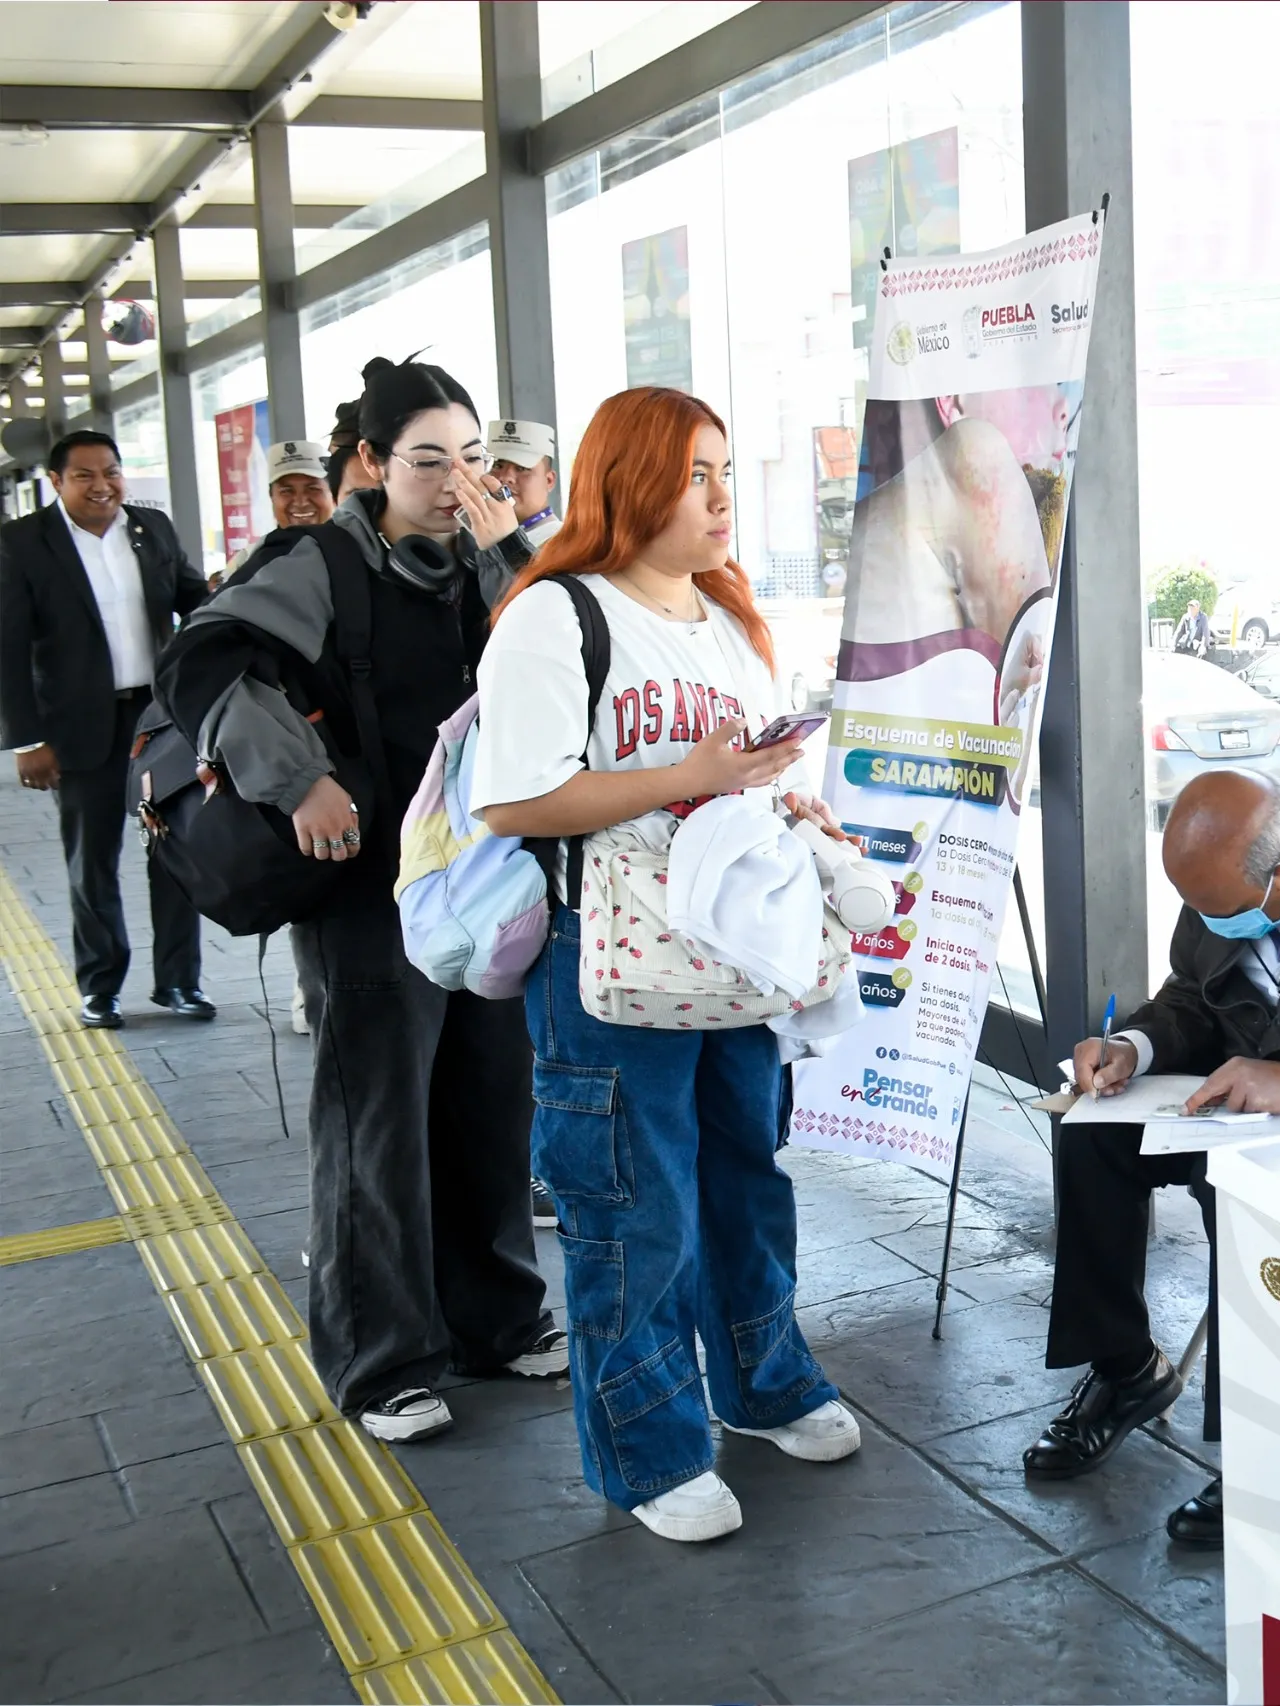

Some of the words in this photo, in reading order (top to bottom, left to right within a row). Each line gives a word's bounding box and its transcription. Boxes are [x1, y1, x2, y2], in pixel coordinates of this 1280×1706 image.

[981, 303, 1035, 327] PUEBLA
[1051, 299, 1089, 324] Salud
[916, 324, 939, 335] Gobierno
[940, 321, 947, 330] de
[982, 328, 1005, 337] Gobierno
[1006, 325, 1014, 334] del
[1015, 324, 1037, 332] Estado
[917, 333, 950, 354] México
[843, 718, 928, 746] Esquema
[934, 729, 953, 749] de
[958, 730, 1021, 759] Vacunación
[869, 757, 995, 797] SARAMPIÓN
[872, 840, 906, 854] meses
[939, 834, 969, 847] DOSIS
[970, 839, 988, 852] CERO
[950, 849, 971, 862] Dosis
[936, 861, 947, 872] 13
[949, 865, 955, 875] y
[958, 865, 966, 875] 18
[931, 890, 976, 909] Esquema
[864, 934, 895, 950] años
[926, 936, 955, 953] Inicia
[956, 946, 962, 954] o
[924, 952, 939, 964] de
[942, 954, 948, 965] 2
[949, 957, 971, 972] dosis.
[861, 983, 897, 999] años
[921, 982, 931, 992] Si
[933, 985, 957, 998] tienes
[920, 997, 938, 1006] una
[940, 999, 960, 1012] dosis.
[918, 1007, 951, 1023] Mayores
[951, 1016, 960, 1024] de
[917, 1019, 927, 1028] ya
[929, 1022, 944, 1032] que
[916, 1031, 957, 1047] vacunados.
[863, 1068, 933, 1098] Pensar
[841, 1084, 873, 1102] en
[865, 1087, 938, 1120] Grande
